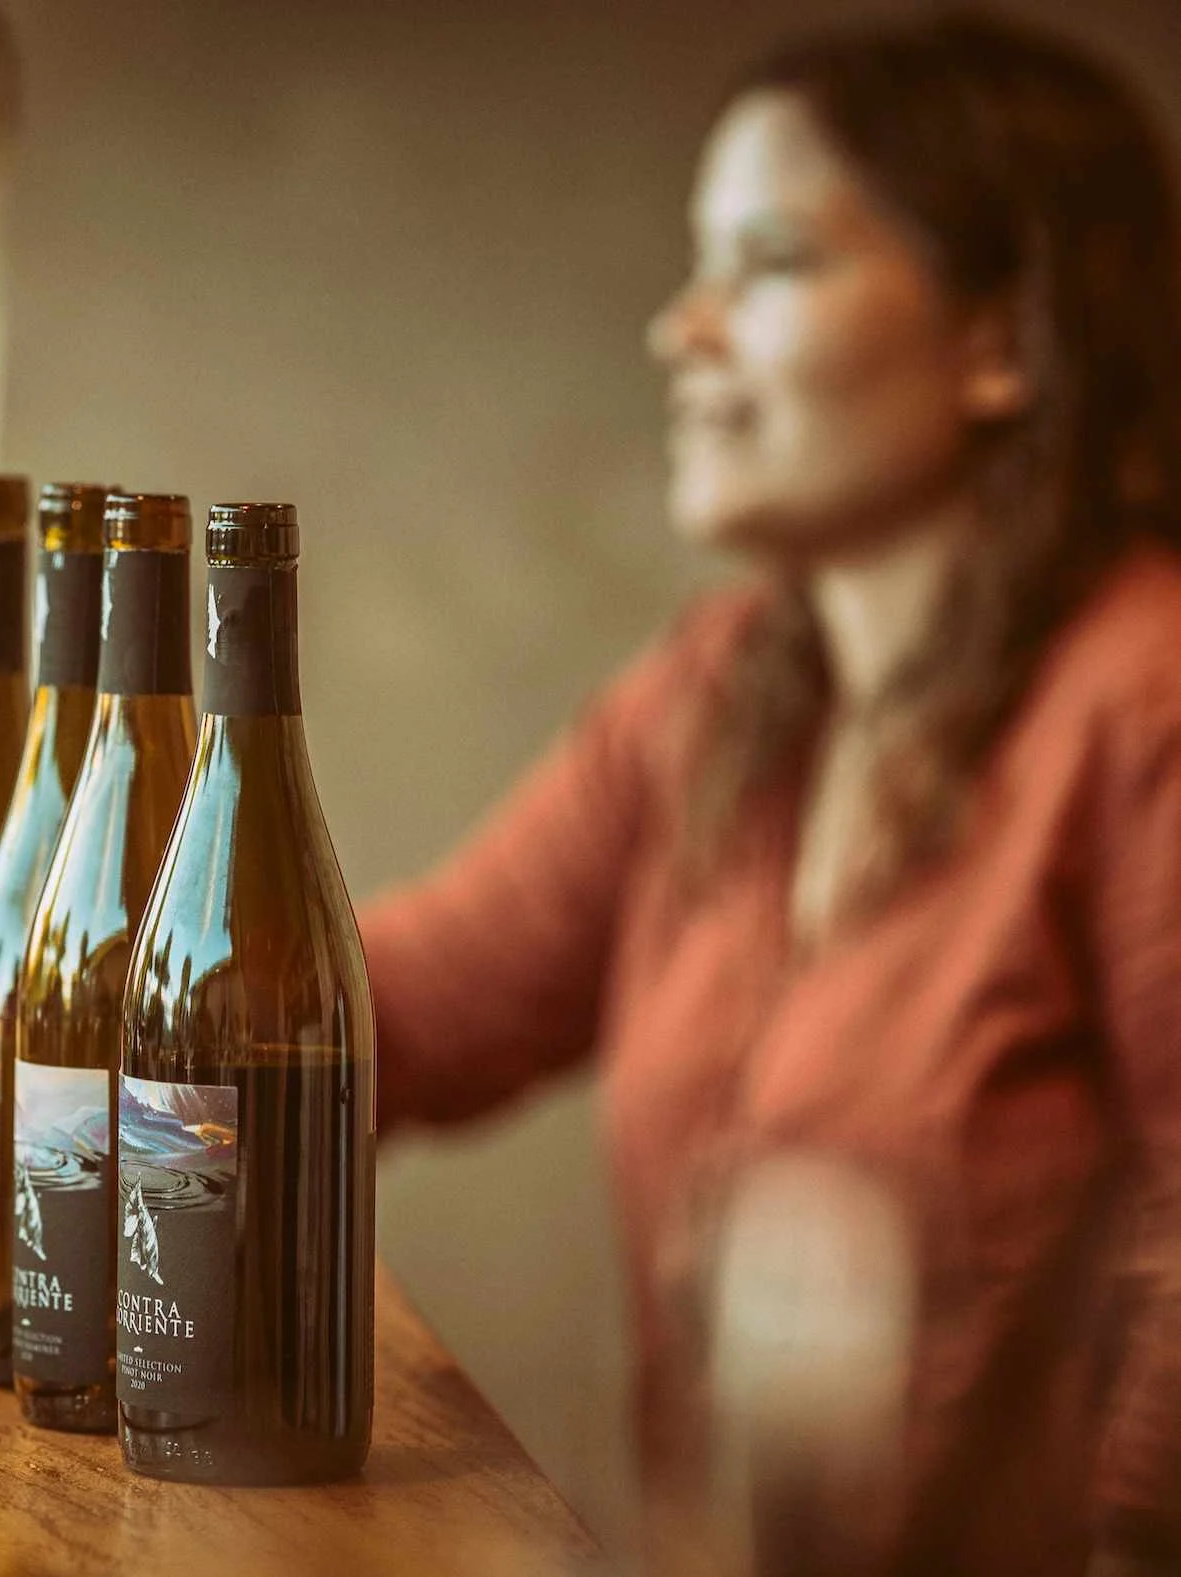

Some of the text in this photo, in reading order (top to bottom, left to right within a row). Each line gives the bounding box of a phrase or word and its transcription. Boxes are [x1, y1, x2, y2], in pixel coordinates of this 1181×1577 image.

[117, 1288, 182, 1321] CONTRA
[134, 1357, 182, 1374] SELECTION
[140, 1369, 163, 1382] NOIR
[130, 1377, 147, 1391] 2020
